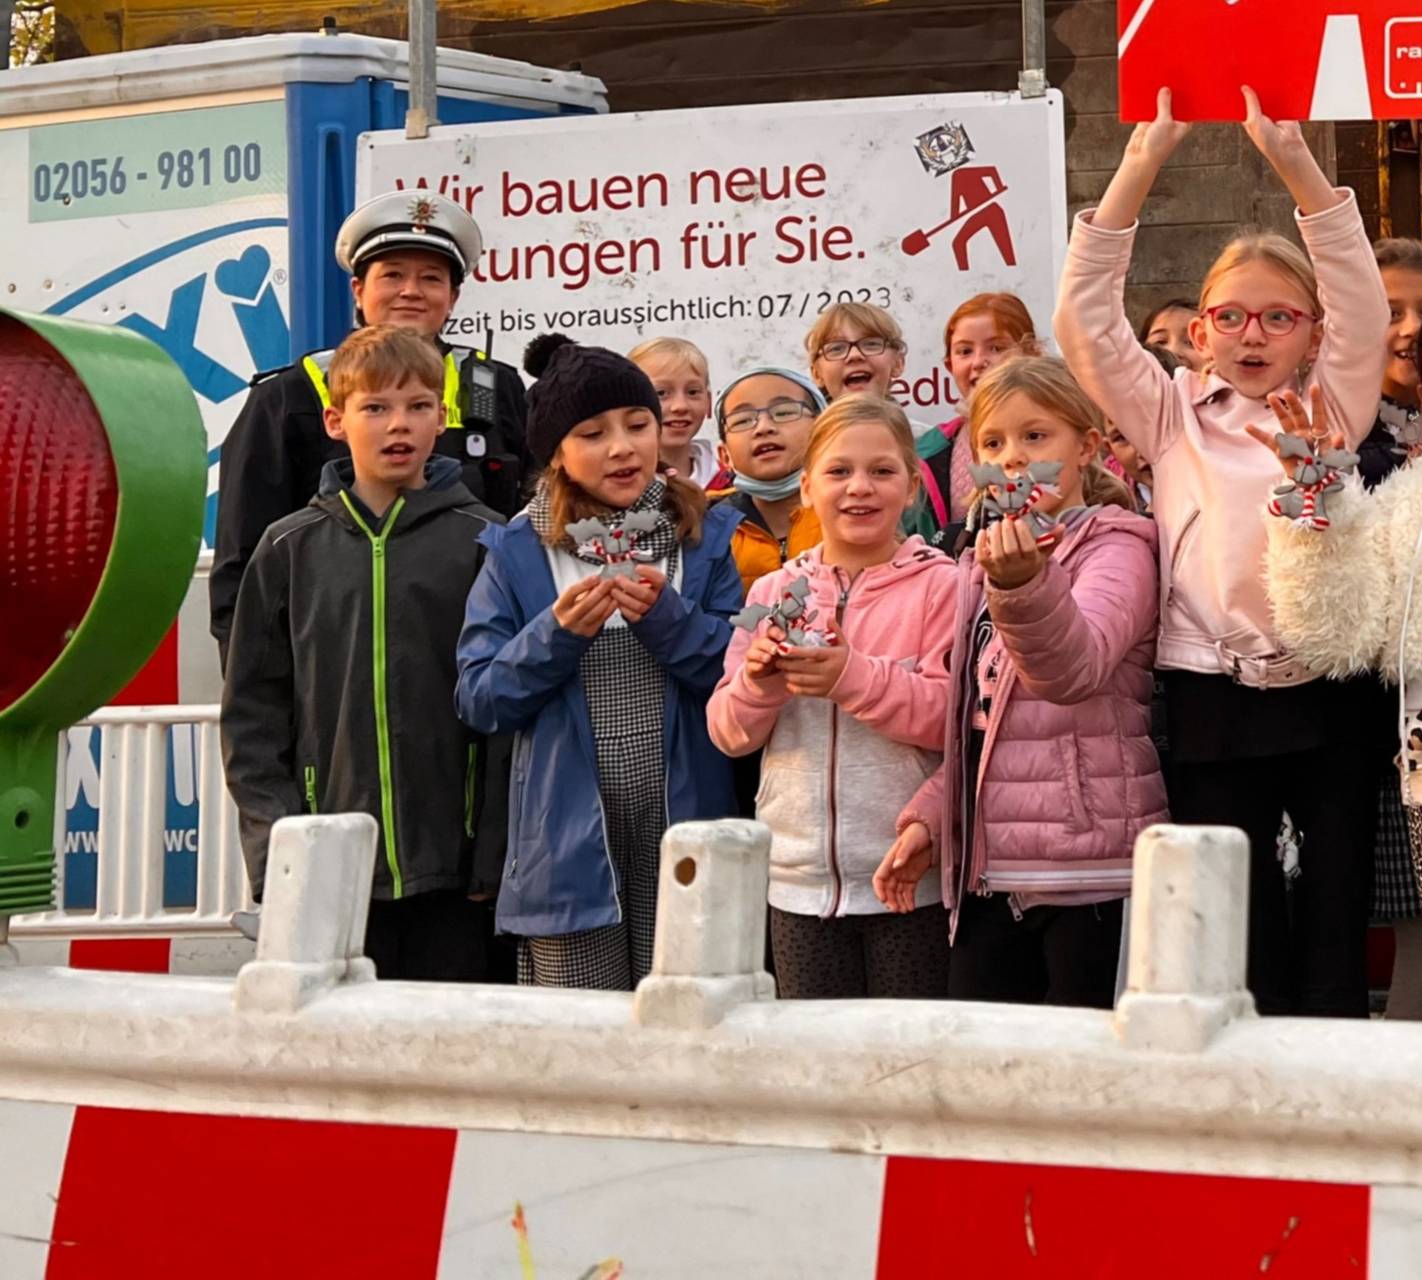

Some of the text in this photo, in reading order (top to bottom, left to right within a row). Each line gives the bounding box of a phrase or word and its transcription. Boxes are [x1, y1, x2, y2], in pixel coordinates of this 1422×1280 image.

[33, 156, 127, 202] 02056
[157, 147, 212, 190] 981
[223, 142, 261, 183] 00
[501, 170, 668, 217] bauen
[690, 162, 827, 205] neue
[680, 221, 757, 271] für
[775, 214, 866, 265] Sie.
[440, 311, 491, 335] zeit
[501, 308, 536, 332] bis
[543, 294, 752, 328] voraussichtlich:
